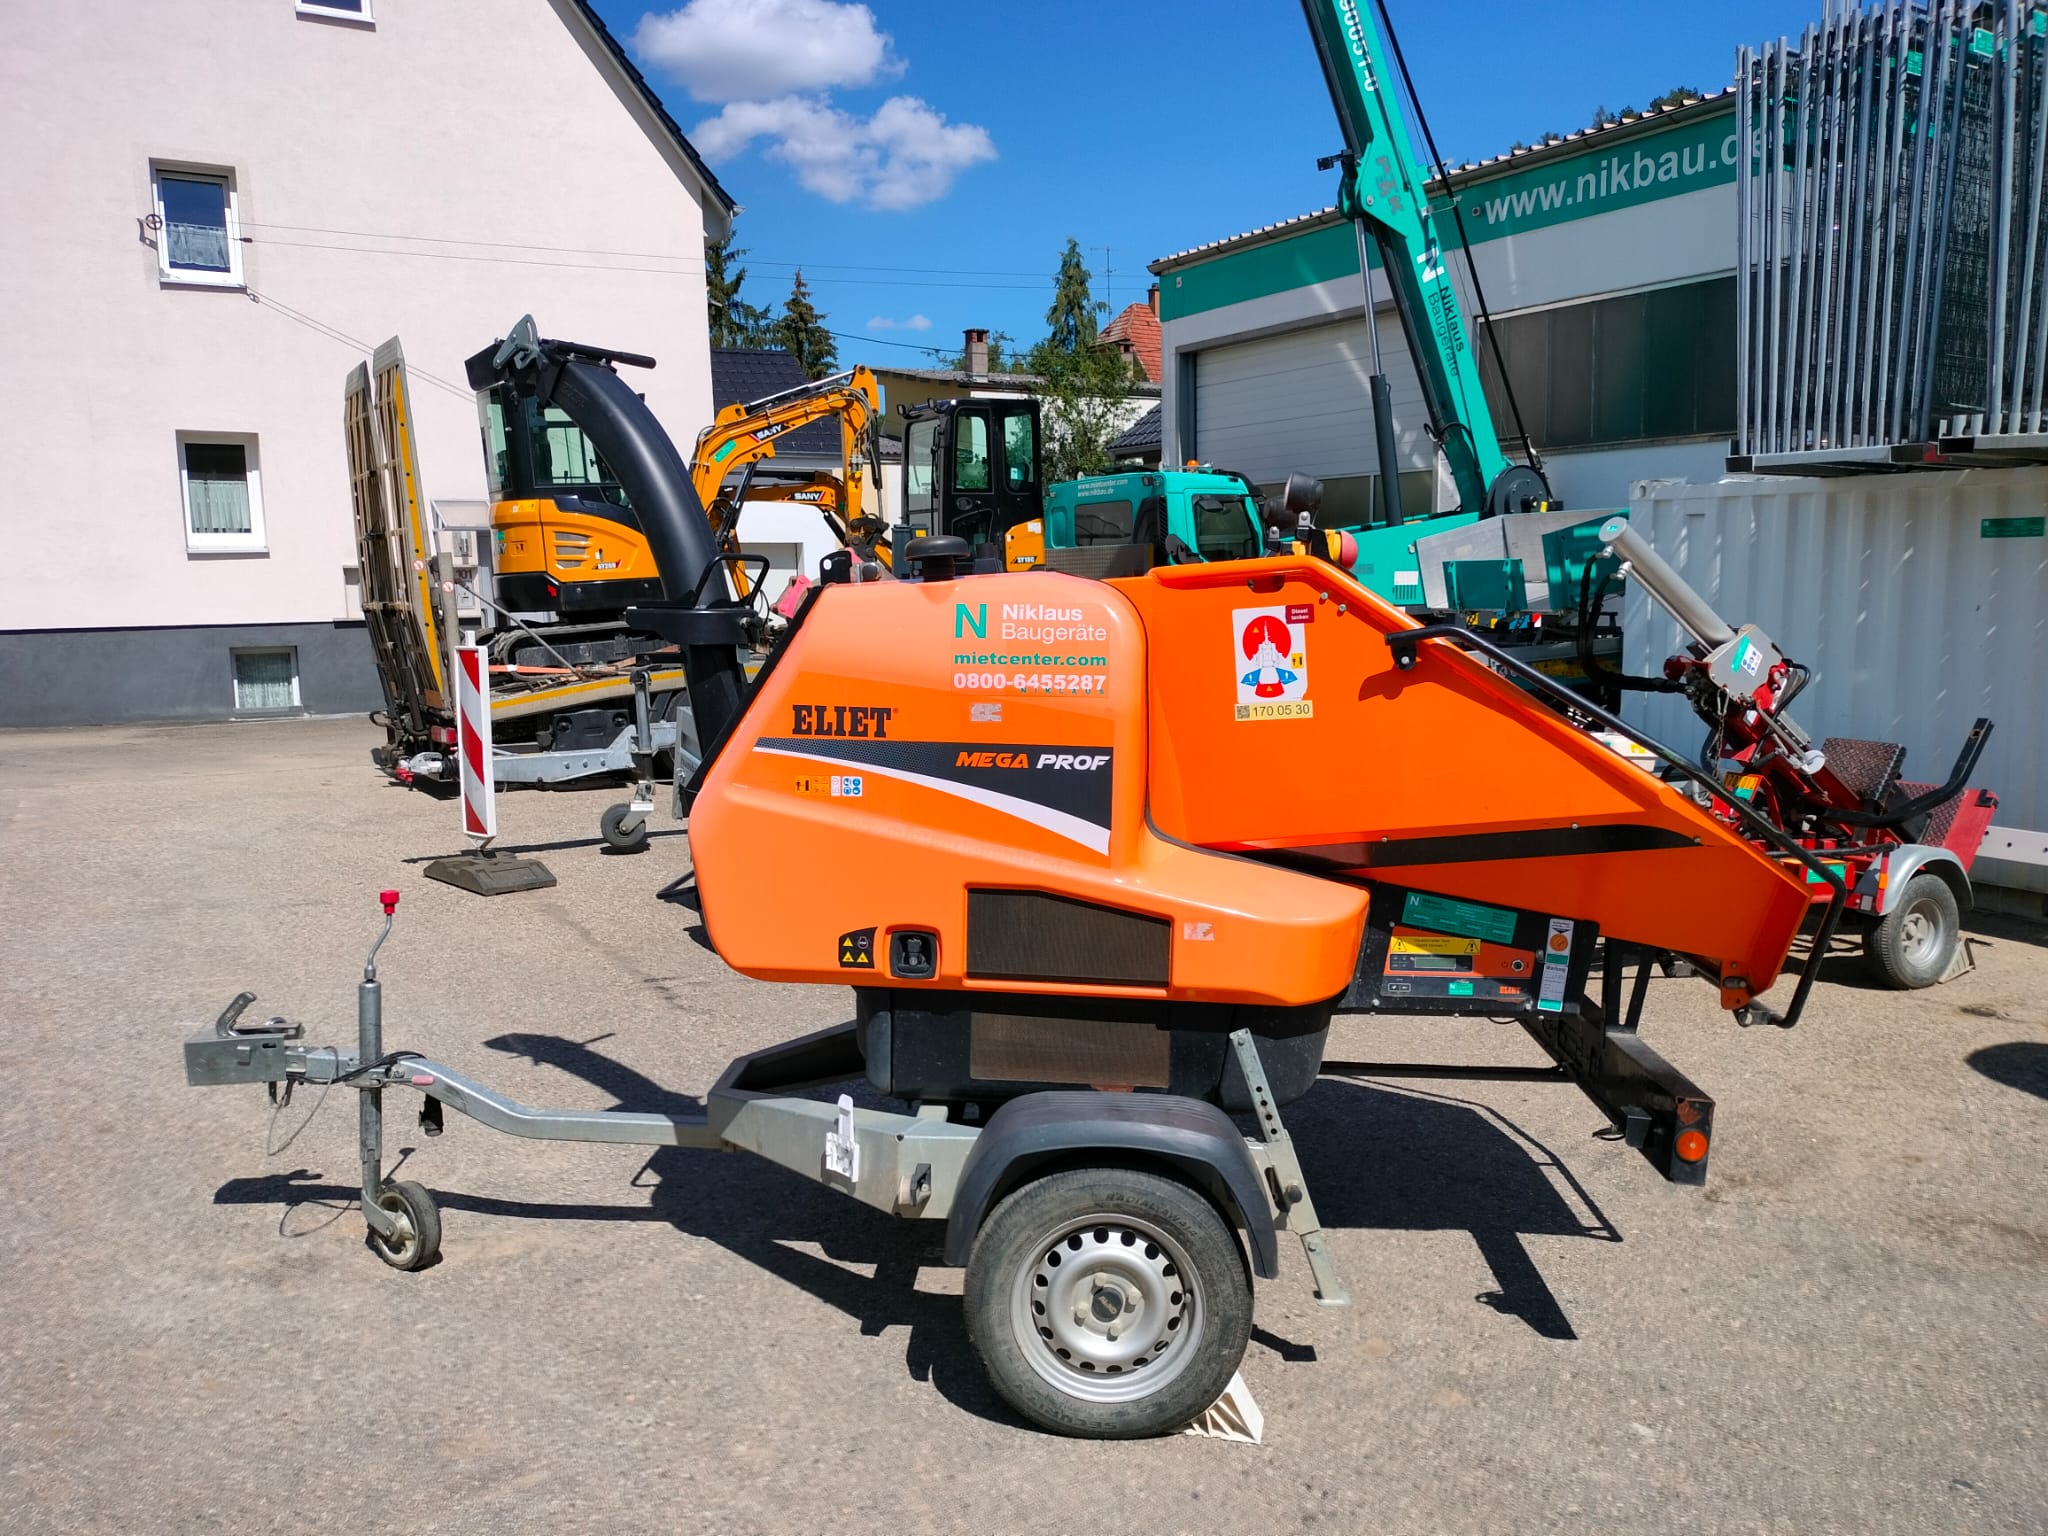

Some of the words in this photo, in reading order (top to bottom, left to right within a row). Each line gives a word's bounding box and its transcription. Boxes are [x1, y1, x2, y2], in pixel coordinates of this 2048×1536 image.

[1416, 246, 1445, 283] N
[1440, 285, 1464, 352] Niklaus
[757, 424, 782, 439] SANY
[955, 603, 987, 638] N
[1002, 604, 1082, 620] Niklaus
[1001, 623, 1107, 644] Baugeräte
[954, 652, 1107, 666] mietcenter.com
[953, 673, 1106, 690] 0800-6455287
[1253, 706, 1274, 717] 170
[1277, 705, 1292, 715] 05
[1295, 704, 1310, 714] 30
[792, 704, 892, 738] ELIET
[955, 752, 1029, 769] MEGA
[1036, 754, 1111, 771] PROF
